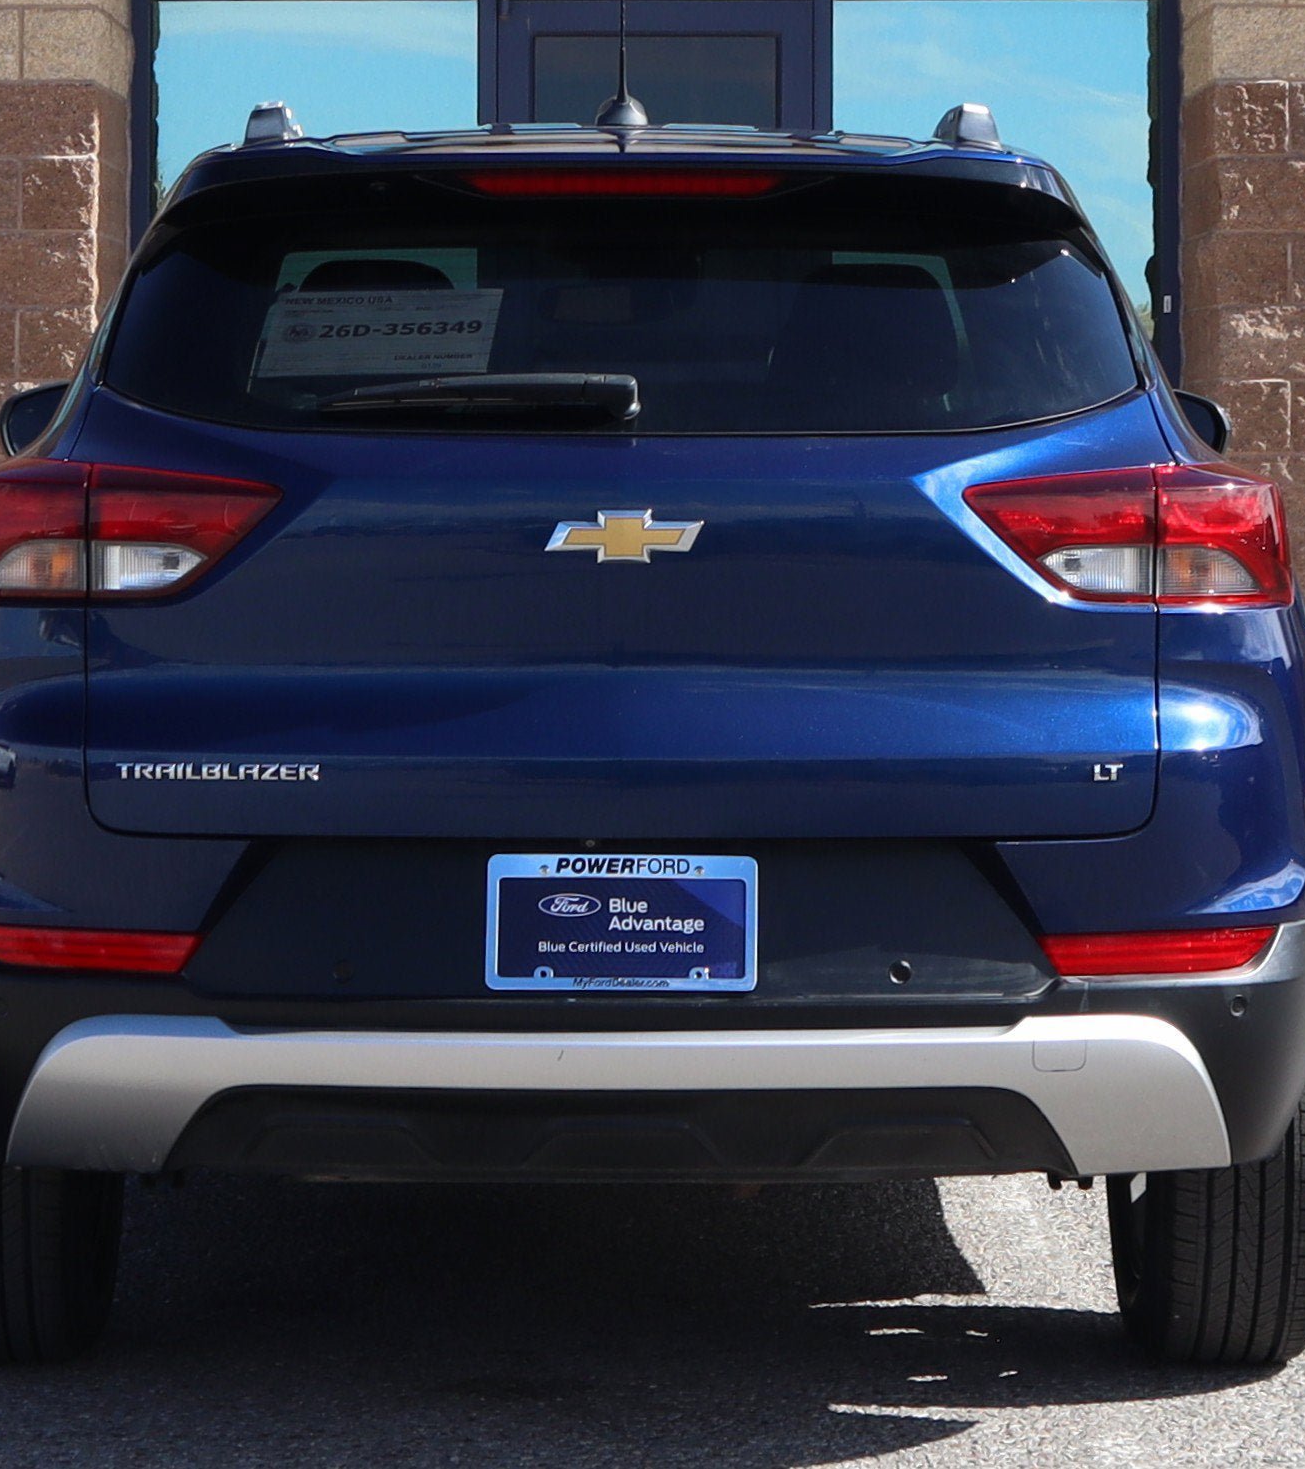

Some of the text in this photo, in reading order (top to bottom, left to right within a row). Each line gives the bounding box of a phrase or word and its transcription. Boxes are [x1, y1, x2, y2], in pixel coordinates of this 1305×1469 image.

[285, 295, 393, 305] NEW MEXICO USA
[318, 320, 482, 339] 26D-356349
[116, 762, 321, 781] TRAILBLAZER
[1094, 764, 1123, 781] LT
[555, 857, 691, 875] POWERFORD
[550, 896, 589, 913] Ford
[609, 898, 648, 913] Blue
[608, 916, 705, 934] Advantage
[538, 941, 705, 953] Blue Certified Used Vehicle
